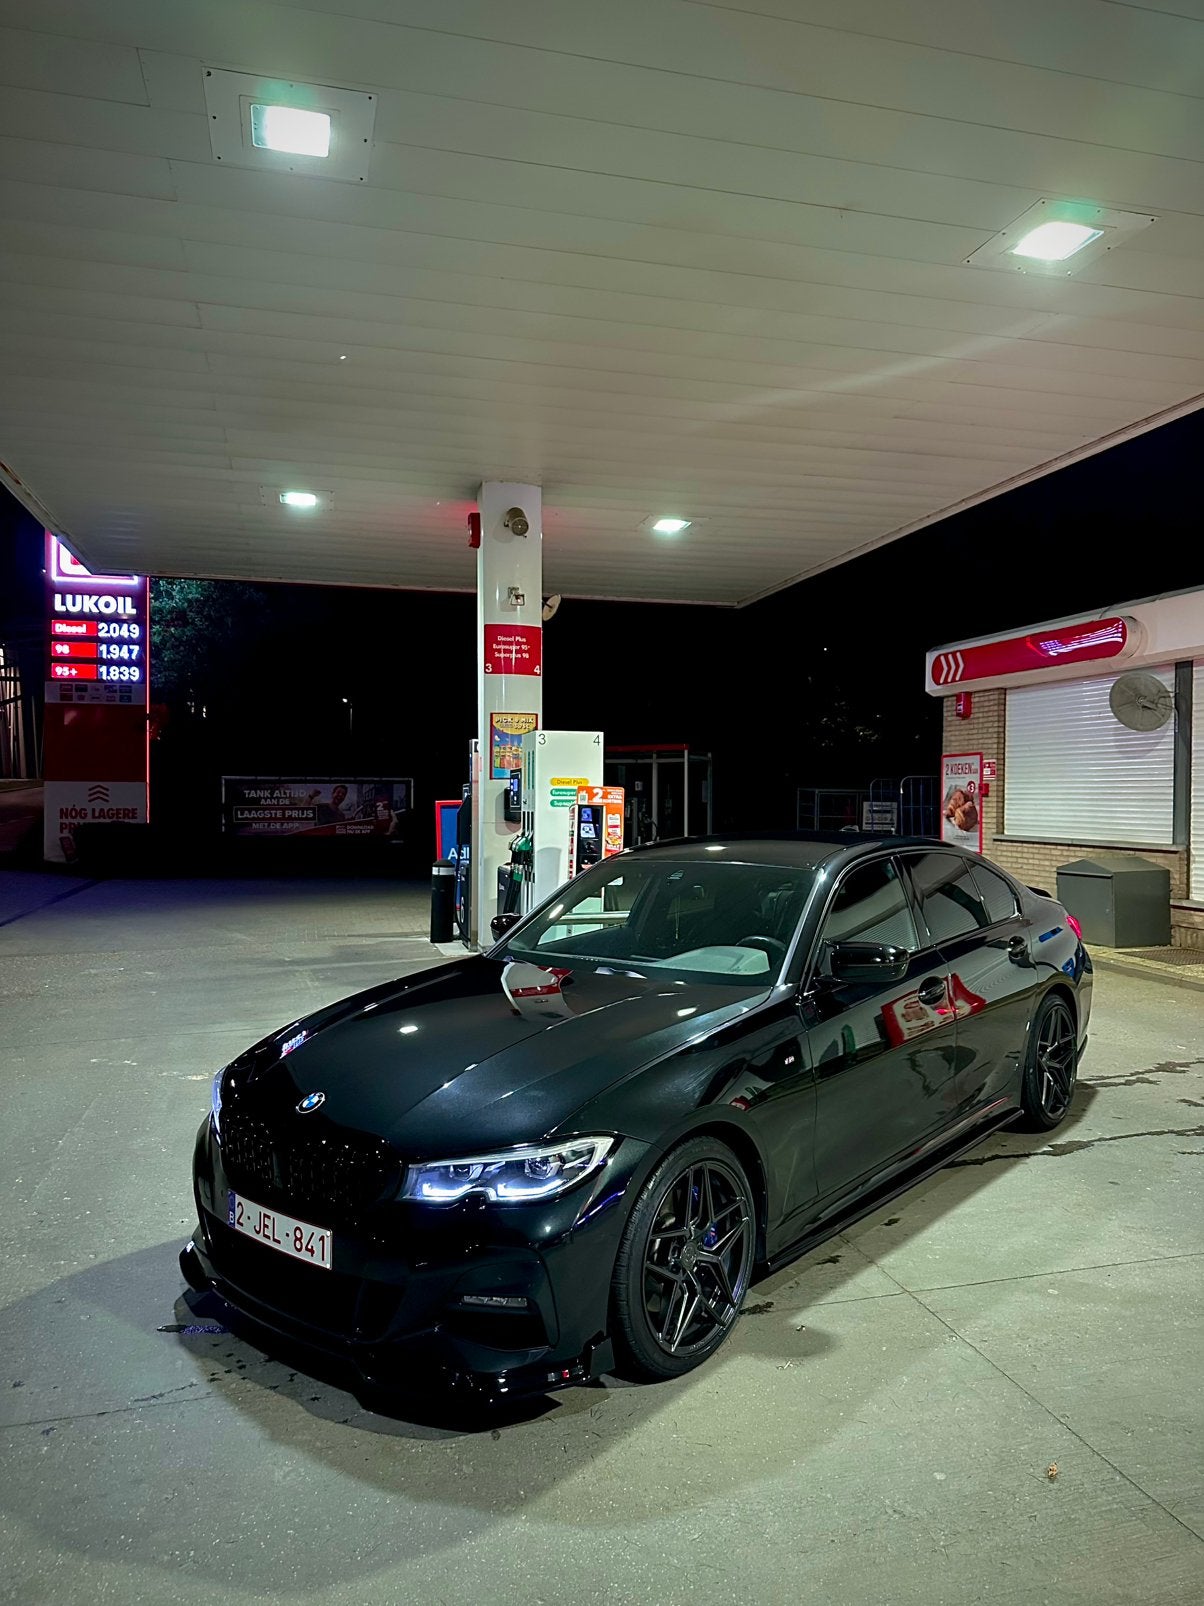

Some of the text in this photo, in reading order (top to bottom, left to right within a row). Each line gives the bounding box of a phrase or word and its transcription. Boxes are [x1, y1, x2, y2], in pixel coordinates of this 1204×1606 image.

[54, 593, 137, 614] LUKOIL
[55, 622, 140, 638] Diesel 2.049
[55, 644, 140, 660] 98 1.947
[55, 665, 140, 681] 95+ 1.839
[485, 664, 492, 672] 3
[534, 665, 540, 674] 4
[538, 733, 547, 746] 3
[593, 734, 601, 746] 4
[243, 790, 272, 798] TANK
[593, 788, 603, 803] 2
[60, 804, 138, 819] NÓG LAGERE
[237, 809, 314, 818] LAAGSTE PRIJS
[229, 1211, 235, 1224] B
